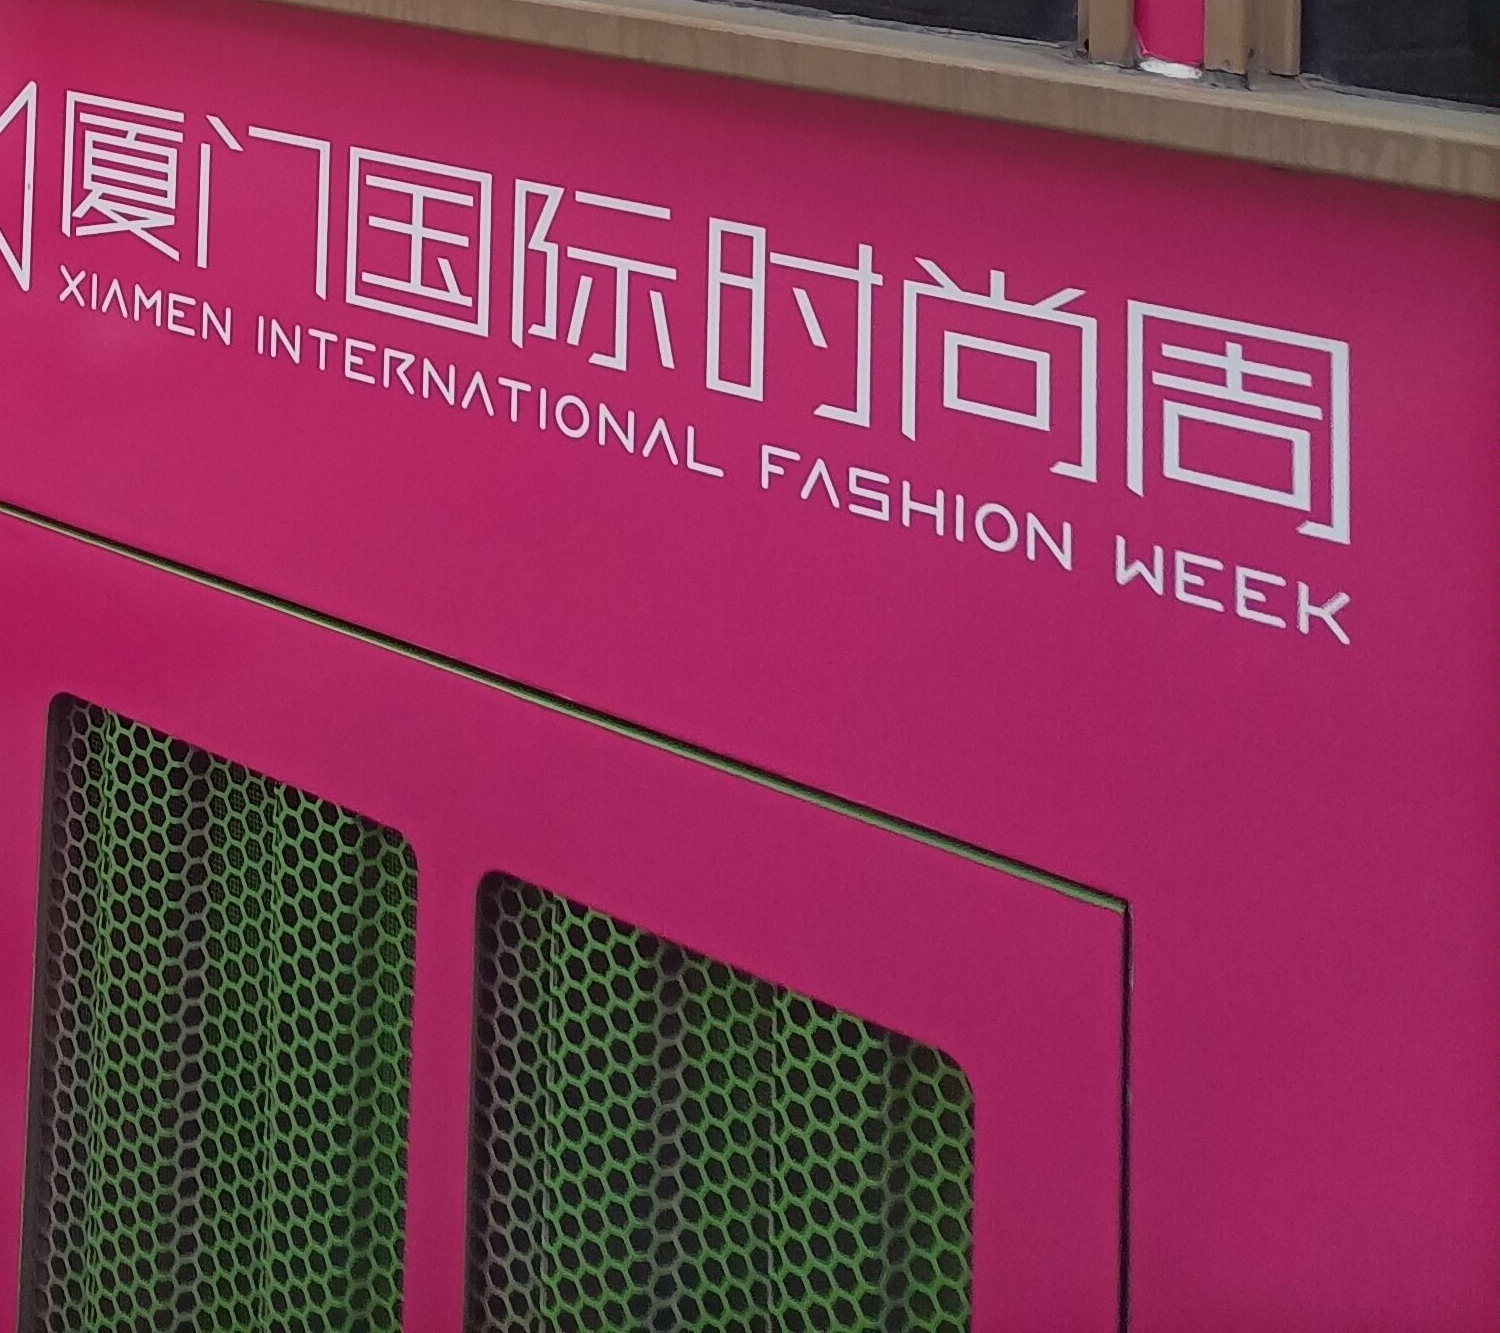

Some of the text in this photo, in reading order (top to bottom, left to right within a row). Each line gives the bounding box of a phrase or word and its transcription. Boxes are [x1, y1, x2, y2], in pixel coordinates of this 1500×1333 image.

[57, 263, 1353, 647] XIAMEN INTERNATIONAL FASHION WEEK
[61, 88, 1353, 546] 厦门国际时尚周
